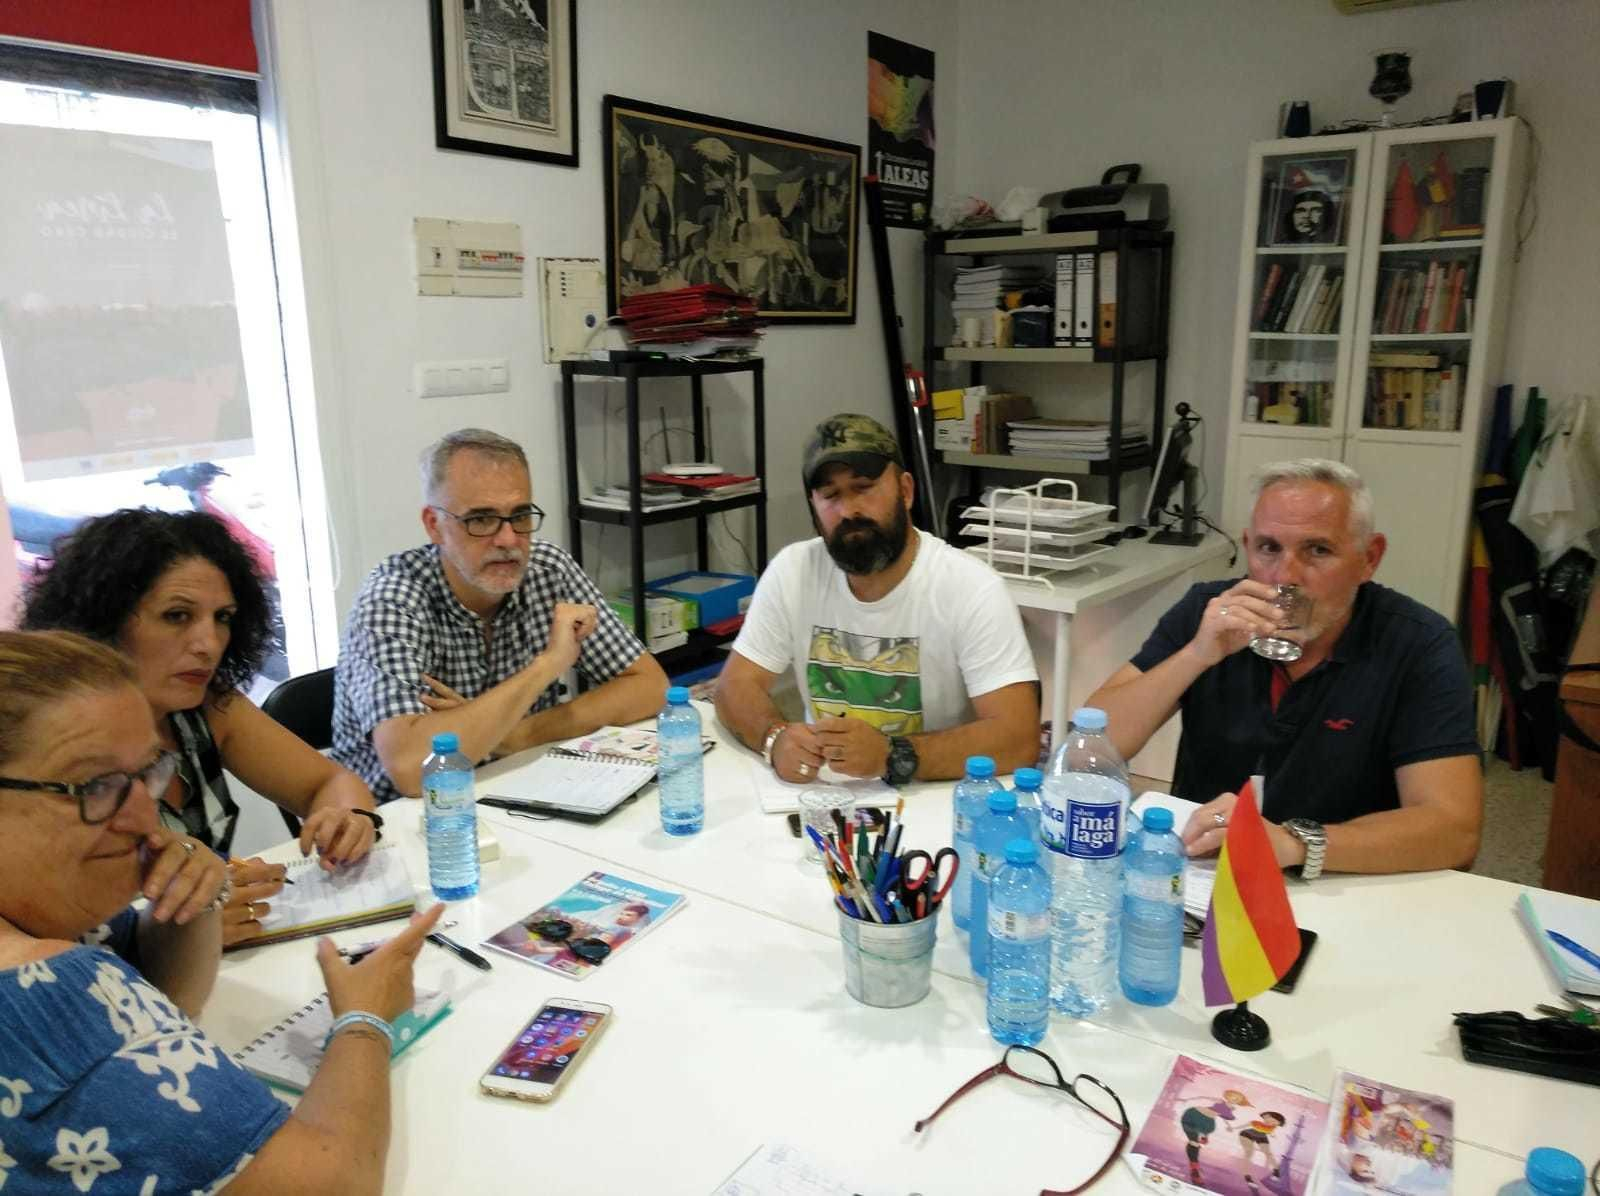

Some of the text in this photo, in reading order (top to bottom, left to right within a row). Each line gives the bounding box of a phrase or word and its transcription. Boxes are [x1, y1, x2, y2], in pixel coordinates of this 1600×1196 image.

[884, 164, 929, 190] ALEAS
[1080, 811, 1115, 831] má
[1072, 823, 1114, 849] laga
